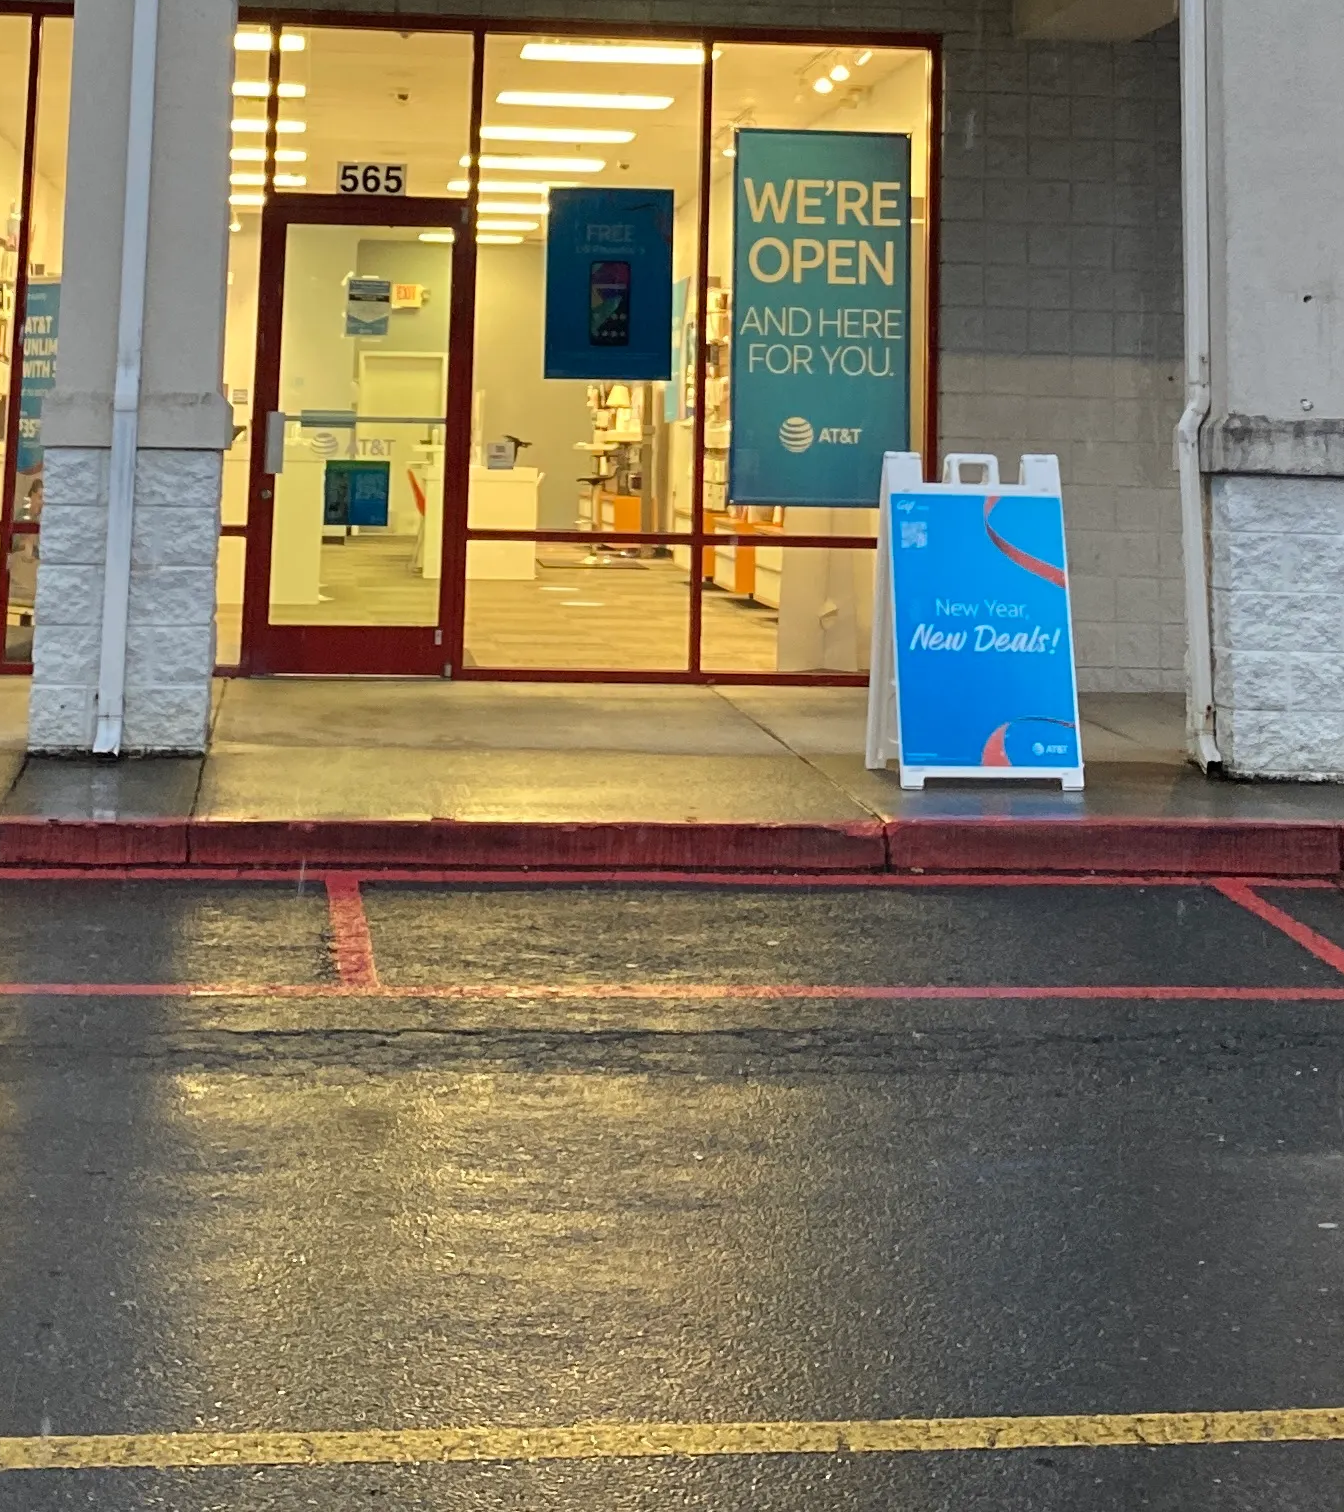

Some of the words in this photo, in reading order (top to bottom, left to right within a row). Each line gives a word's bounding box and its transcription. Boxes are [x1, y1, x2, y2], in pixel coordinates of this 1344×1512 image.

[340, 165, 402, 193] 565
[743, 177, 901, 226] WE'RE
[586, 224, 636, 242] FREE
[748, 237, 894, 285] OPEN
[24, 316, 53, 335] AT&T
[739, 306, 812, 337] AND
[819, 308, 902, 339] HERE
[23, 360, 51, 379] WITH
[749, 343, 813, 374] FOR
[820, 345, 895, 377] YOU.
[818, 428, 862, 444] AT&T
[345, 439, 396, 456] AT&T
[935, 598, 979, 617] New
[984, 599, 1030, 620] Year,
[909, 623, 967, 651] New
[974, 624, 1061, 654] Deals!
[1046, 745, 1068, 754] AT&T
